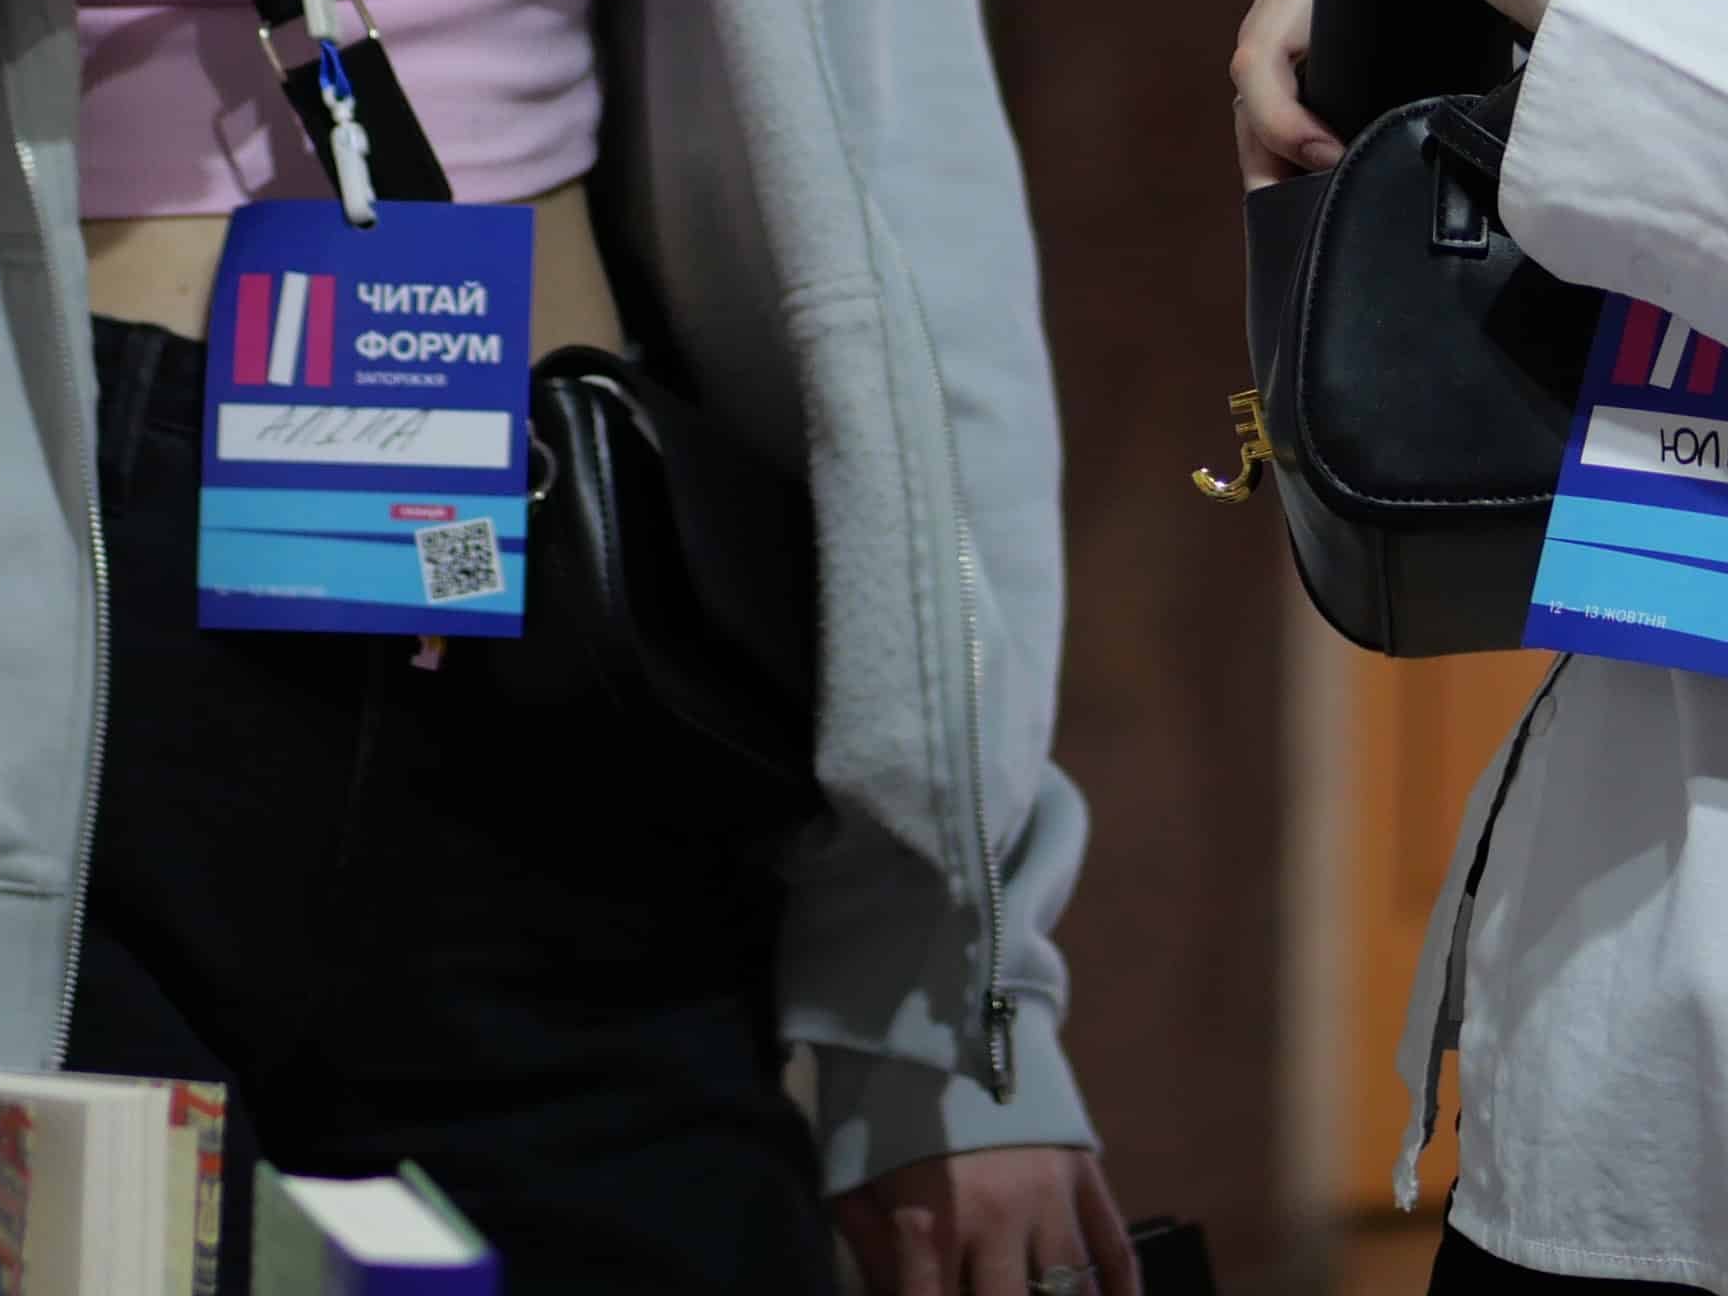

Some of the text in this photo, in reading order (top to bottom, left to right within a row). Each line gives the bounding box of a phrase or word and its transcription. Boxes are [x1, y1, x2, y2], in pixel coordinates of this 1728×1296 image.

[357, 280, 488, 316] ЧИТАЙ
[355, 330, 502, 364] ФОРУМ
[1549, 599, 1563, 615] 12
[1584, 604, 1600, 619] 13
[1602, 607, 1668, 629] ЖОВТНЯ
